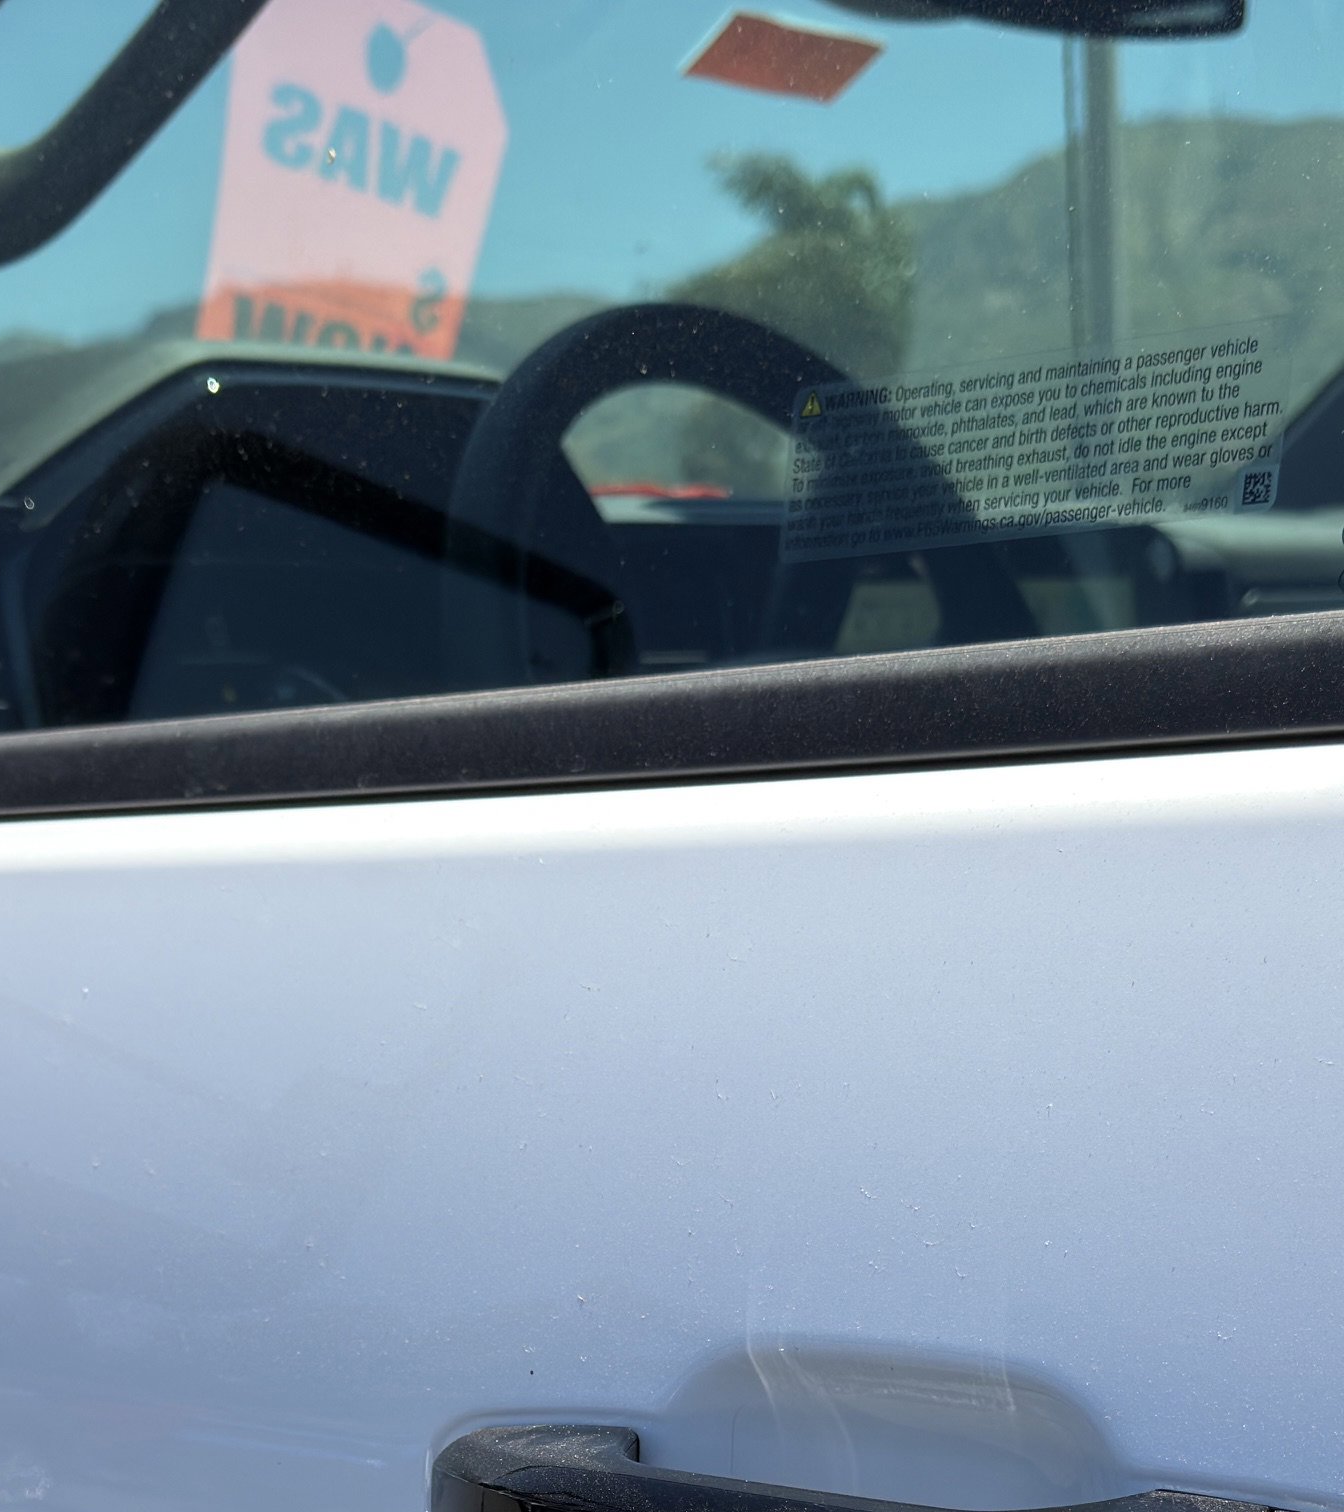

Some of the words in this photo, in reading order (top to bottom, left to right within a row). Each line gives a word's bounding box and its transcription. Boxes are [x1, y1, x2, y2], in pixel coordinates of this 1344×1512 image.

[825, 386, 892, 411] WARNING:
[896, 382, 955, 404] Operating,
[959, 372, 1014, 392] servicing
[1018, 367, 1042, 384] and
[1046, 358, 1120, 380] maintaining
[1124, 357, 1132, 370] a
[1136, 347, 1206, 372] passenger
[1210, 336, 1258, 358] vehicle
[882, 407, 916, 423] motor
[920, 400, 962, 418] vehicle
[965, 399, 987, 412] can
[991, 392, 1034, 410] expose
[1038, 388, 1060, 406] you
[1065, 384, 1076, 398] to
[1081, 373, 1146, 397] chemicals
[1151, 366, 1211, 385] including
[1216, 359, 1262, 380] engine
[793, 458, 822, 474] State
[910, 443, 945, 459] cause
[948, 437, 988, 455] cancer
[992, 431, 1015, 448] and
[1018, 428, 1047, 446] birth
[1050, 422, 1097, 442] defects
[1100, 422, 1114, 435] or
[1118, 416, 1152, 434] other
[1156, 406, 1239, 430] reproductive
[1244, 400, 1283, 418] harm.
[888, 422, 948, 442] monoxide,
[952, 414, 1018, 437] phthalates,
[1022, 407, 1046, 425] and
[1050, 402, 1078, 420] lead,
[1084, 398, 1122, 418] which
[1126, 398, 1147, 412] are
[1152, 390, 1196, 408] known
[1202, 386, 1214, 401] to
[1219, 383, 1240, 399] the
[792, 478, 804, 493] To
[920, 460, 951, 477] avoid
[956, 453, 1014, 474] breathing
[1017, 446, 1070, 466] exhaust,
[1074, 444, 1089, 460] do
[1093, 442, 1114, 457] not
[1118, 437, 1142, 454] idle
[1146, 435, 1166, 450] the
[1171, 428, 1216, 450] engine
[1221, 422, 1268, 442] except
[942, 477, 983, 495] vehicle
[987, 475, 998, 490] in
[1002, 476, 1009, 488] a
[1013, 462, 1106, 487] well-ventilated
[1110, 460, 1138, 476] area
[1143, 454, 1168, 472] and
[1173, 452, 1206, 468] wear
[1210, 448, 1254, 468] gloves
[1258, 444, 1272, 458] or
[948, 497, 980, 514] when
[984, 490, 1039, 510] servicing
[1043, 488, 1072, 508] your
[1075, 480, 1122, 500] vehicle.
[1131, 478, 1156, 494] For
[1157, 475, 1191, 490] more
